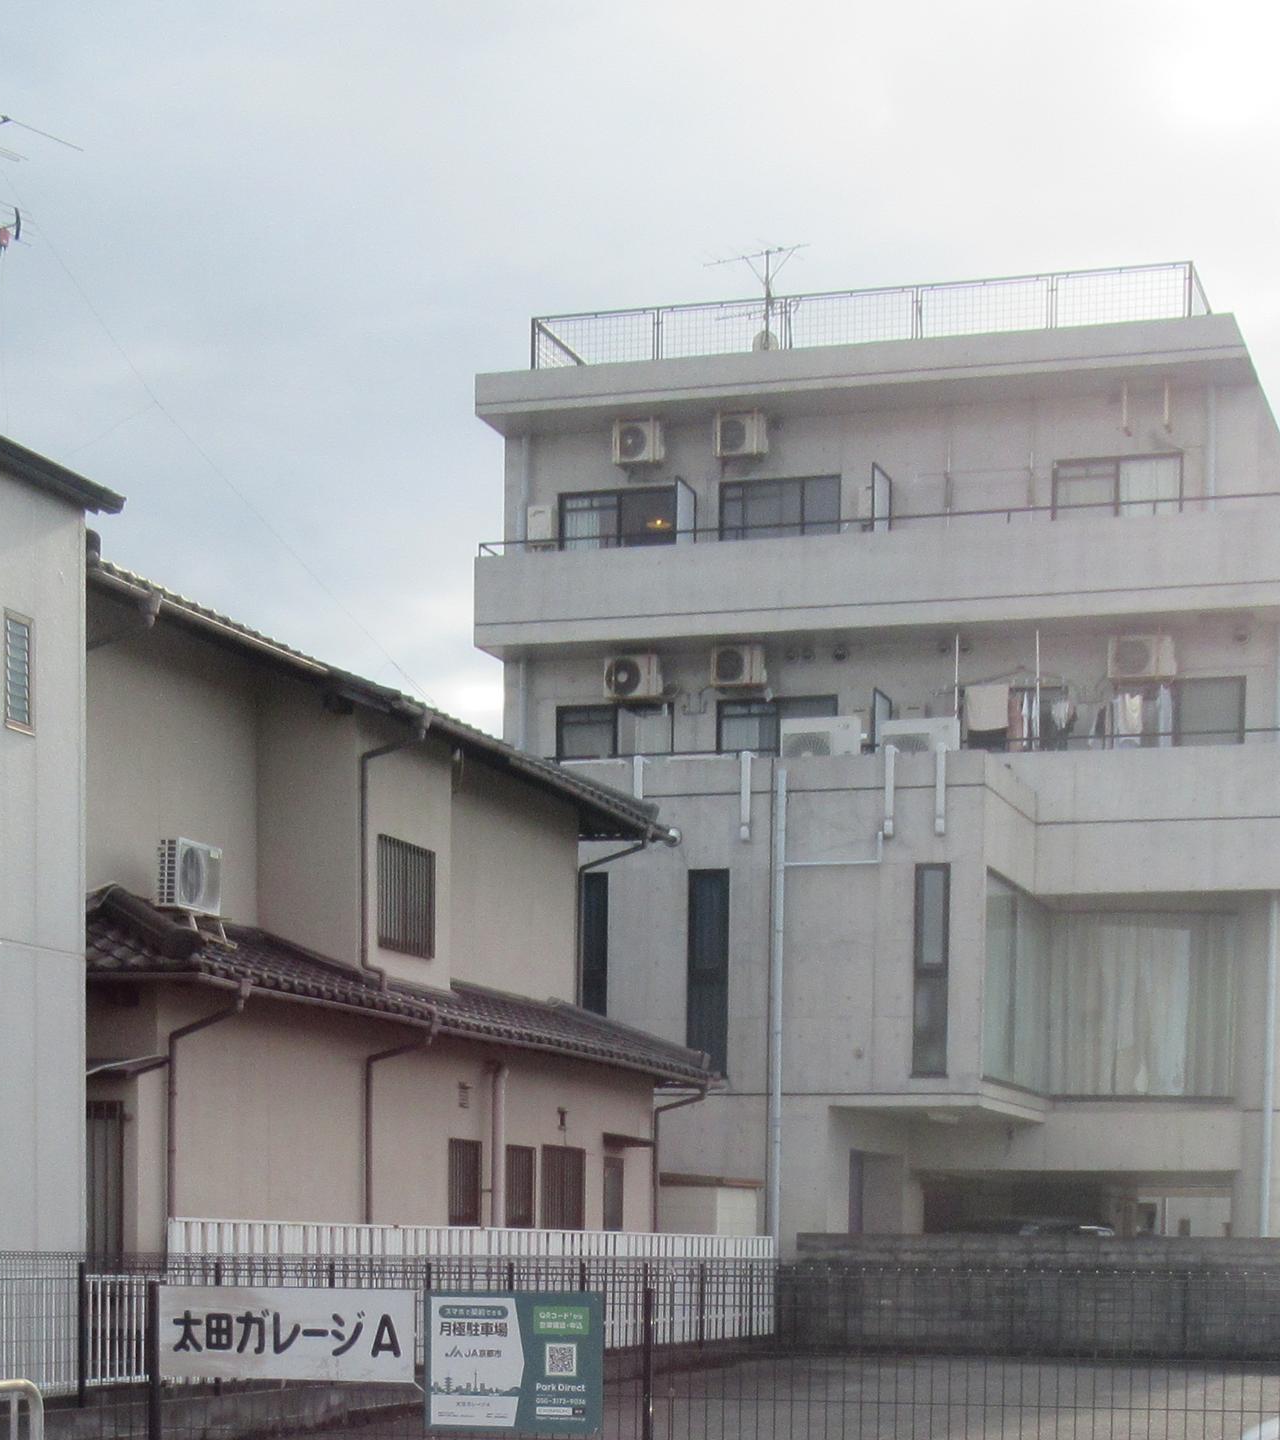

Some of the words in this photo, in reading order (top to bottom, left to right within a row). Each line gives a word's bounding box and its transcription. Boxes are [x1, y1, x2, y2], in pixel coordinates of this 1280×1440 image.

[440, 1321, 508, 1337] 月極駐車場
[558, 1383, 586, 1392] Direct
